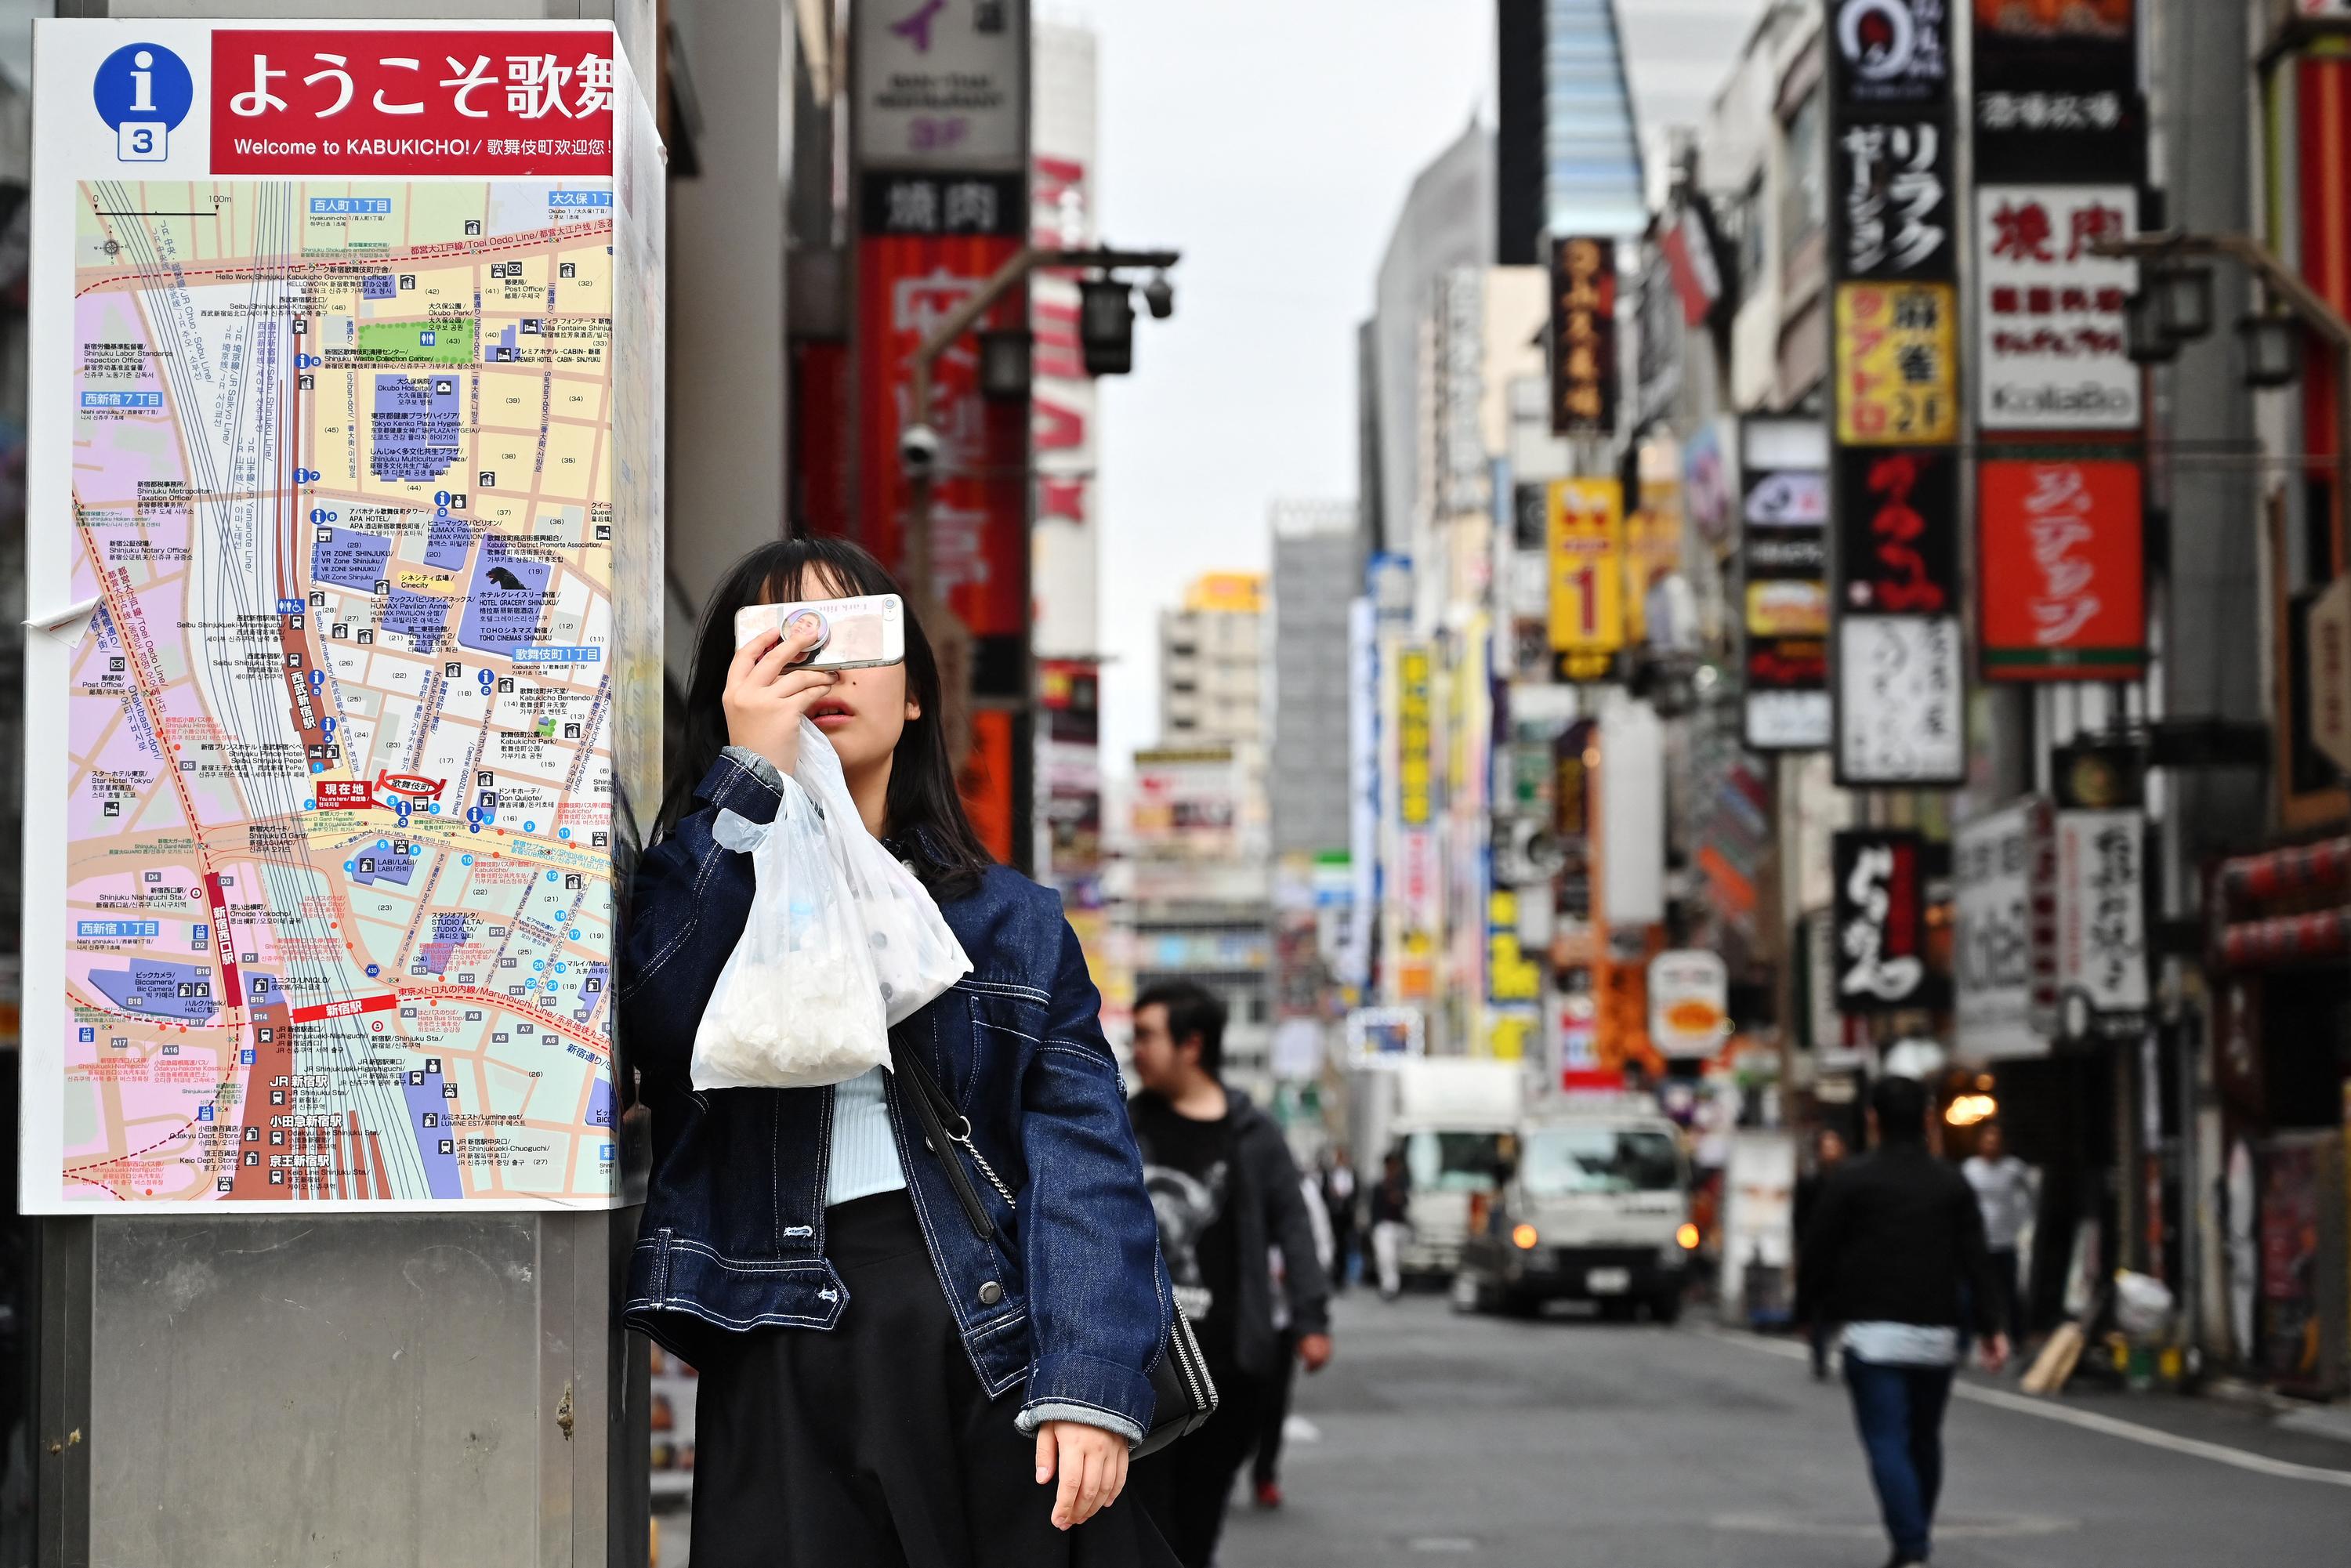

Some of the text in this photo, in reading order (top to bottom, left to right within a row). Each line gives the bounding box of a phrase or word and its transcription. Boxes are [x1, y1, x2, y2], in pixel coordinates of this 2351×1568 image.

[230, 53, 614, 118] ようこそ歌舞
[132, 129, 154, 153] 3
[234, 139, 316, 155] Welcome
[324, 139, 340, 155] to
[1890, 121, 1944, 270] リラク
[314, 200, 387, 211] 百人町1丁目
[1991, 201, 2125, 263] 焼肉
[490, 236, 513, 245] Oedo
[85, 393, 158, 405] 西新宿7丁目
[1567, 564, 1596, 636] 1
[516, 649, 597, 661] 歌舞伎町1丁目
[290, 671, 317, 730] 西武新宿駅
[325, 784, 364, 795] 現在地
[392, 779, 429, 791] 歌舞伎町
[82, 923, 155, 935] 西新宿1丁目
[213, 906, 234, 965] 新宿西口駅
[326, 1001, 362, 1016] 新宿駅
[270, 1075, 328, 1088] JR 新宿駅
[270, 1115, 342, 1128] 小田急新宿駅
[270, 1155, 330, 1168] 京王新宿駅
